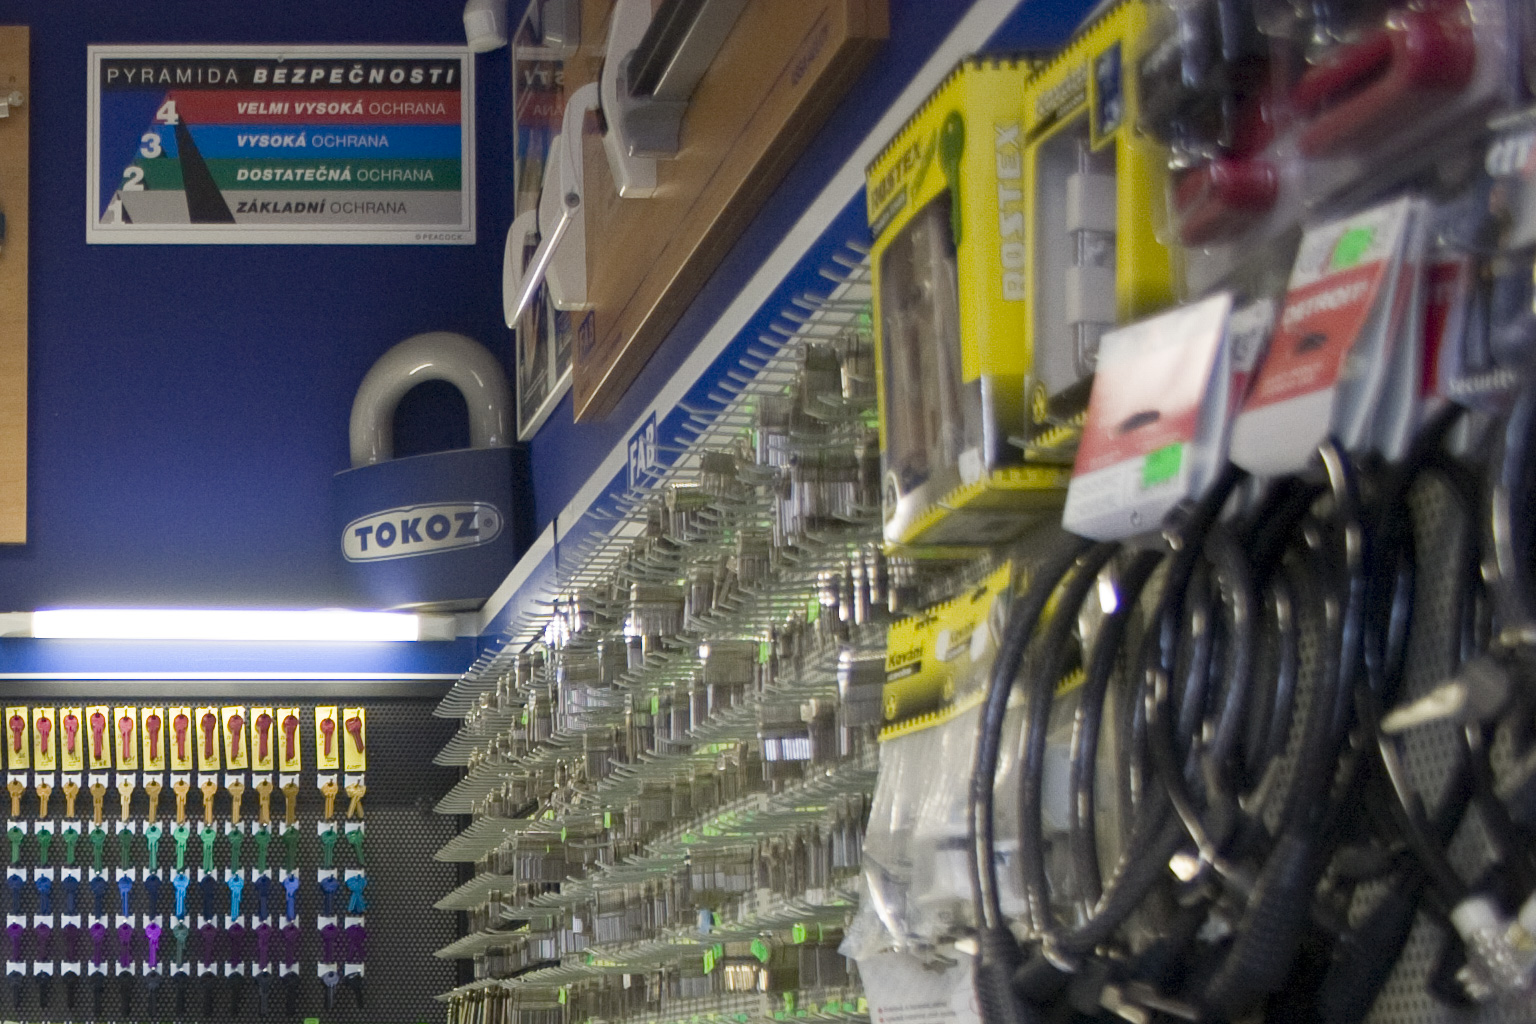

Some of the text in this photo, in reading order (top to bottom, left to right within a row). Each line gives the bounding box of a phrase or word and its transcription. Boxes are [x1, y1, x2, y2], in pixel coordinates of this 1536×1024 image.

[107, 65, 456, 84] PYRAMIDA BEZPEČNOSTI
[156, 100, 179, 125] 4
[237, 100, 446, 115] VELMI VYSOKÁ OCHRANA
[140, 133, 162, 159] 3
[237, 132, 389, 148] VYSOKÁ OCHRANA
[123, 166, 144, 191] 2
[237, 166, 434, 182] DOSTATEČNÁ OCHRANA
[109, 199, 125, 225] 1
[236, 200, 407, 215] ZÁKLADNÍ OCHRANA
[994, 122, 1026, 302] ROSTEX
[629, 423, 655, 487] FAB
[354, 511, 480, 552] TOKOZ
